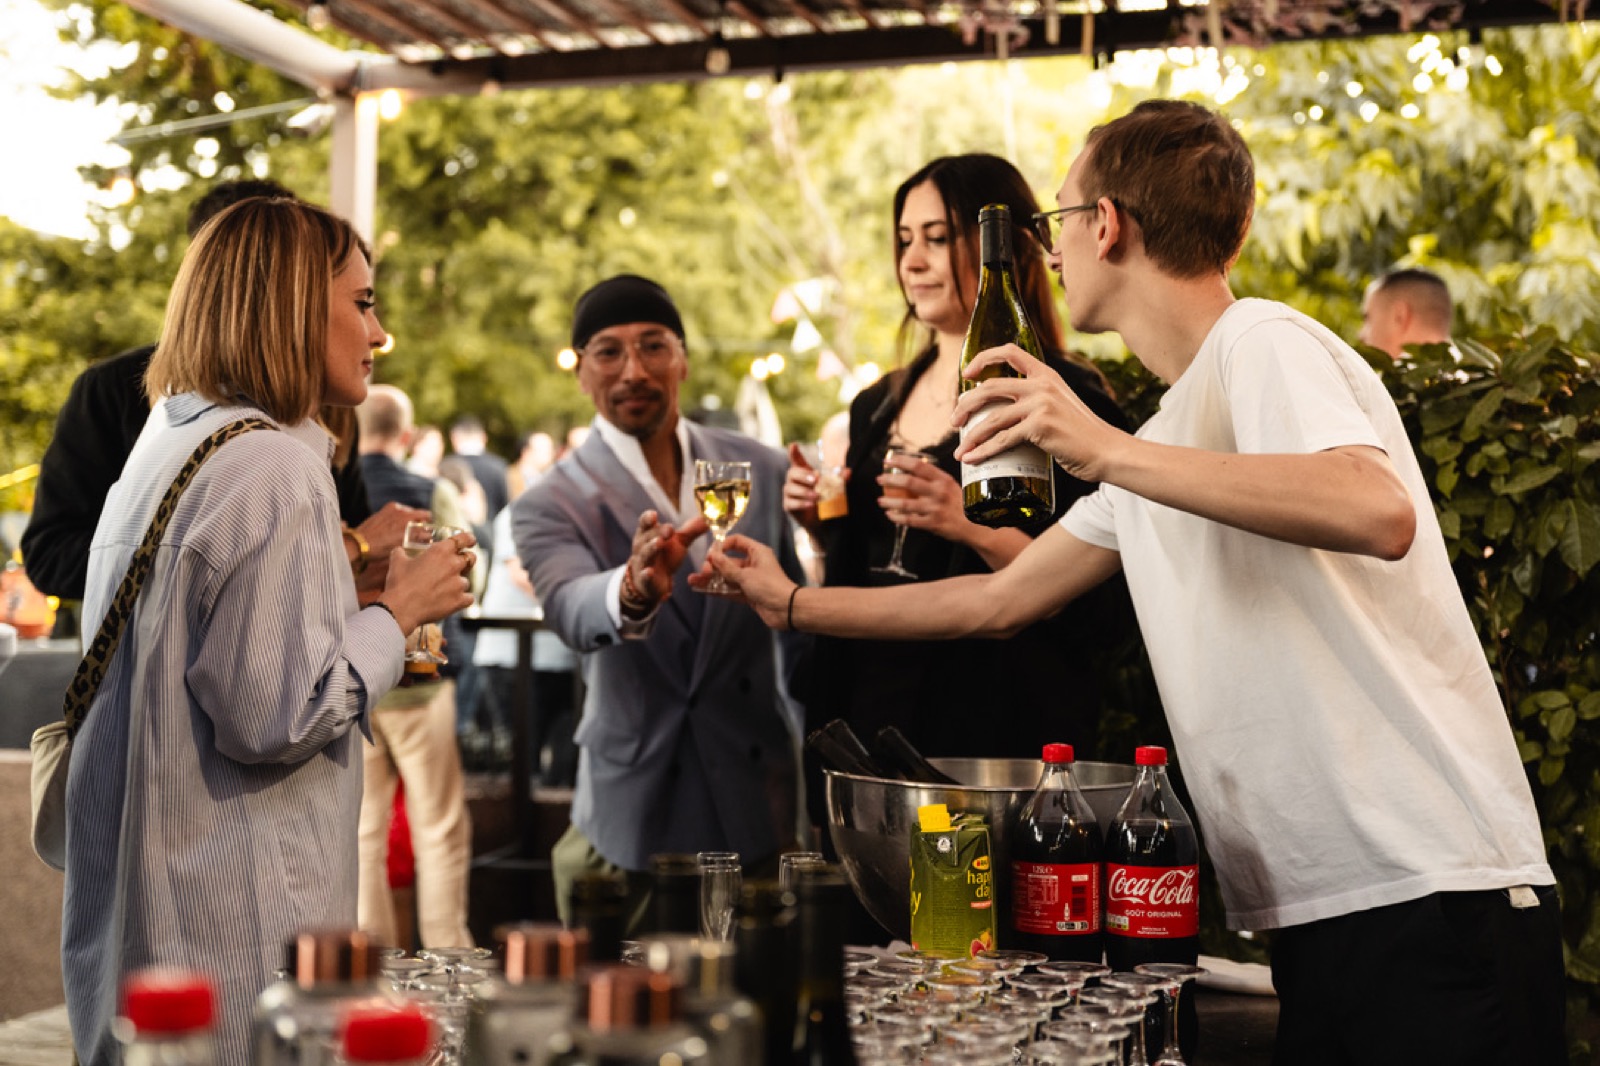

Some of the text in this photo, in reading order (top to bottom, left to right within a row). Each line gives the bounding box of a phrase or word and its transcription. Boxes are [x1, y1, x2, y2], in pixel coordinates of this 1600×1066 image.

[1108, 868, 1196, 905] Coca-Cola
[1124, 908, 1183, 918] GOÛT ORIGINAL
